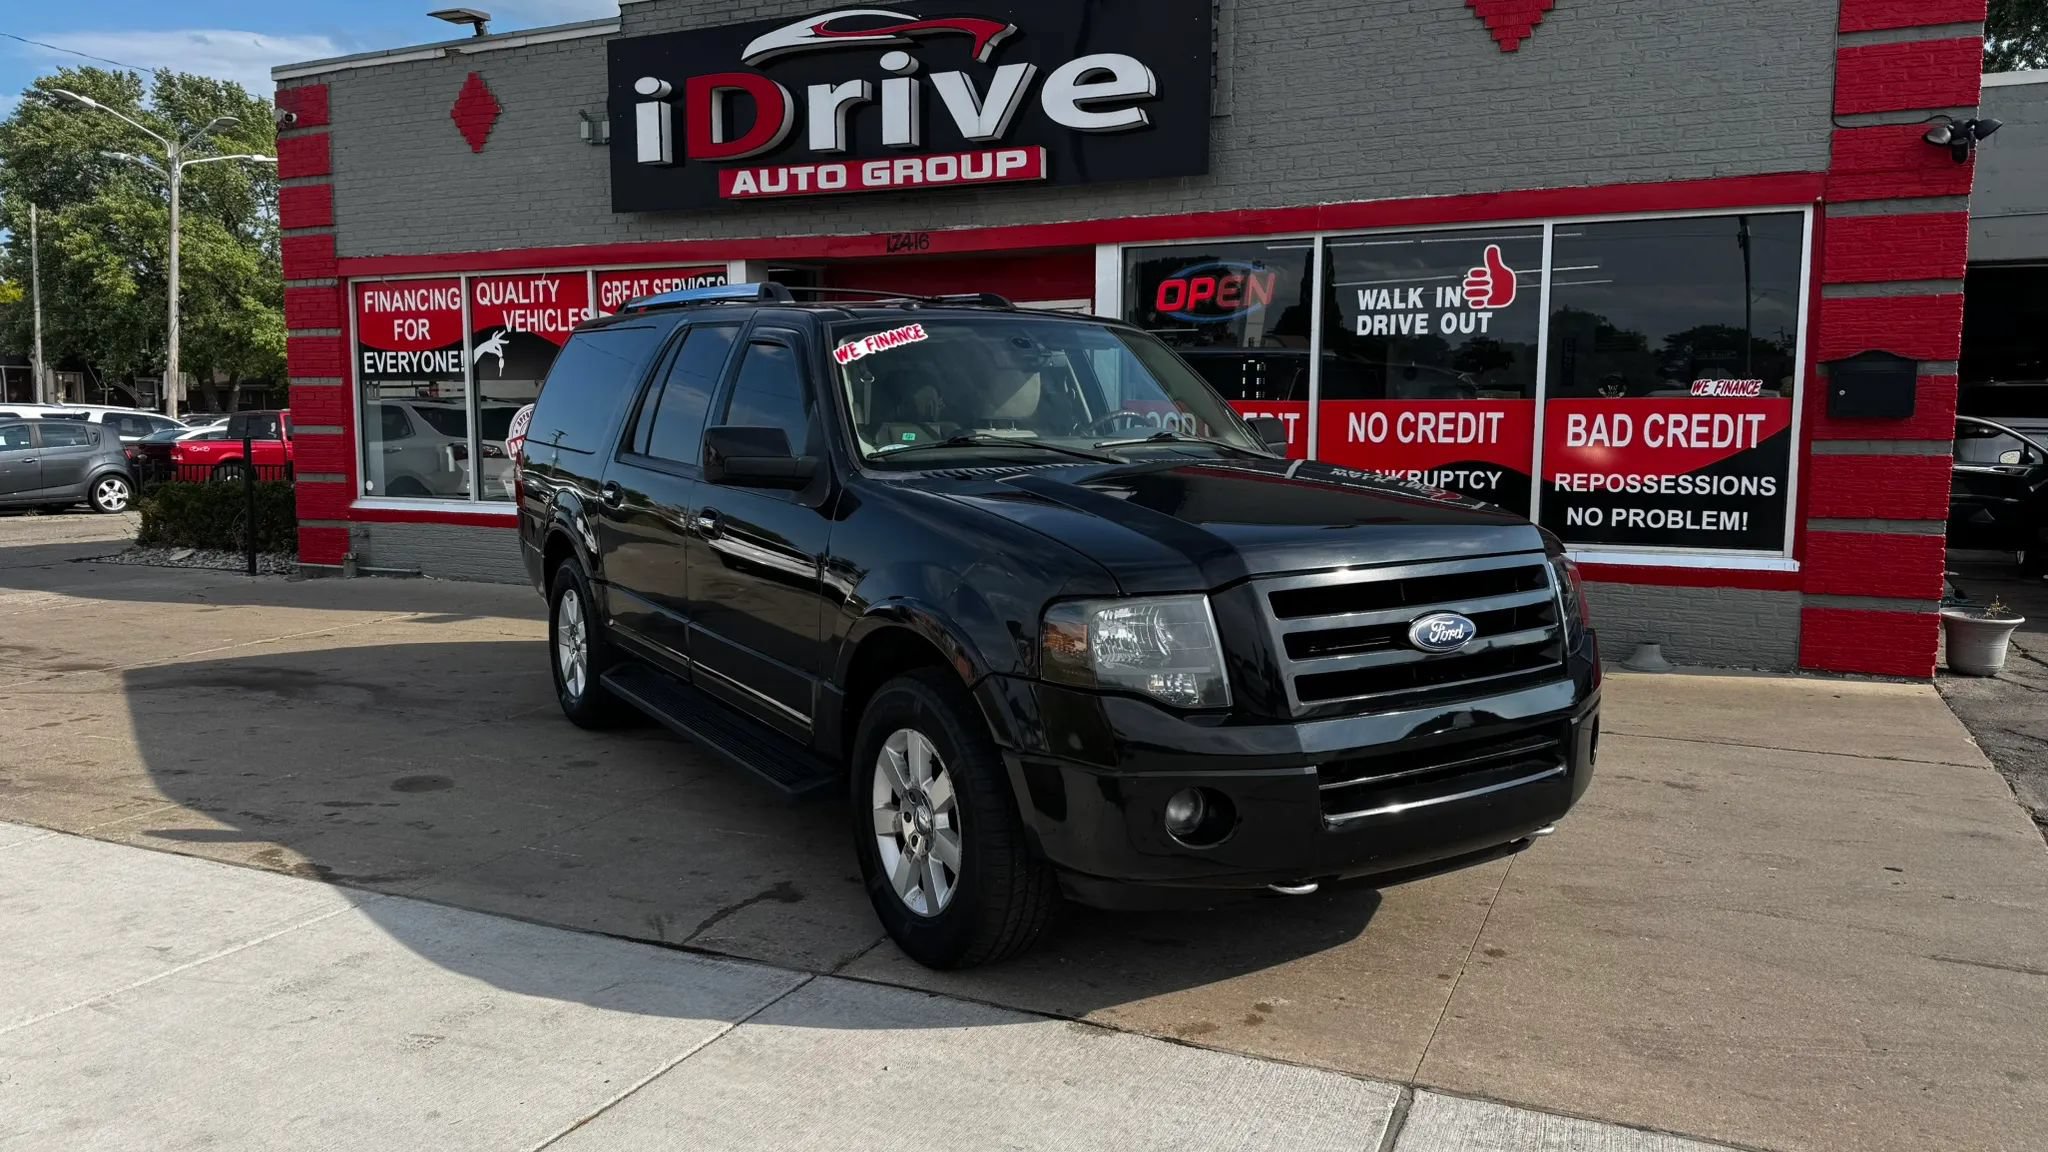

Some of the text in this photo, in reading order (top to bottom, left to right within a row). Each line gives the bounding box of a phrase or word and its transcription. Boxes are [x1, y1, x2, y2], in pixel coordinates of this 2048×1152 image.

[635, 51, 1157, 166] iDrive
[731, 149, 1028, 195] AUTO GROUP
[364, 287, 461, 313] FINANCING
[476, 279, 560, 306] QUALITY
[601, 279, 649, 307] GREAT
[1156, 272, 1277, 313] OPEN
[1357, 286, 1463, 311] WALK IN
[393, 318, 431, 341] FOR
[1356, 311, 1493, 336] DRIVE OUT
[834, 324, 925, 362] WE FINANCE
[363, 350, 465, 373] EVERYONE!
[1692, 379, 1761, 395] WE FINANCE
[1348, 411, 1504, 444] NO CREDIT
[1566, 413, 1766, 449] BAD CREDIT
[1554, 473, 1777, 497] REPOSSESSIONS
[1566, 507, 1748, 531] NO PROBLEM!
[1429, 620, 1465, 643] Ford
